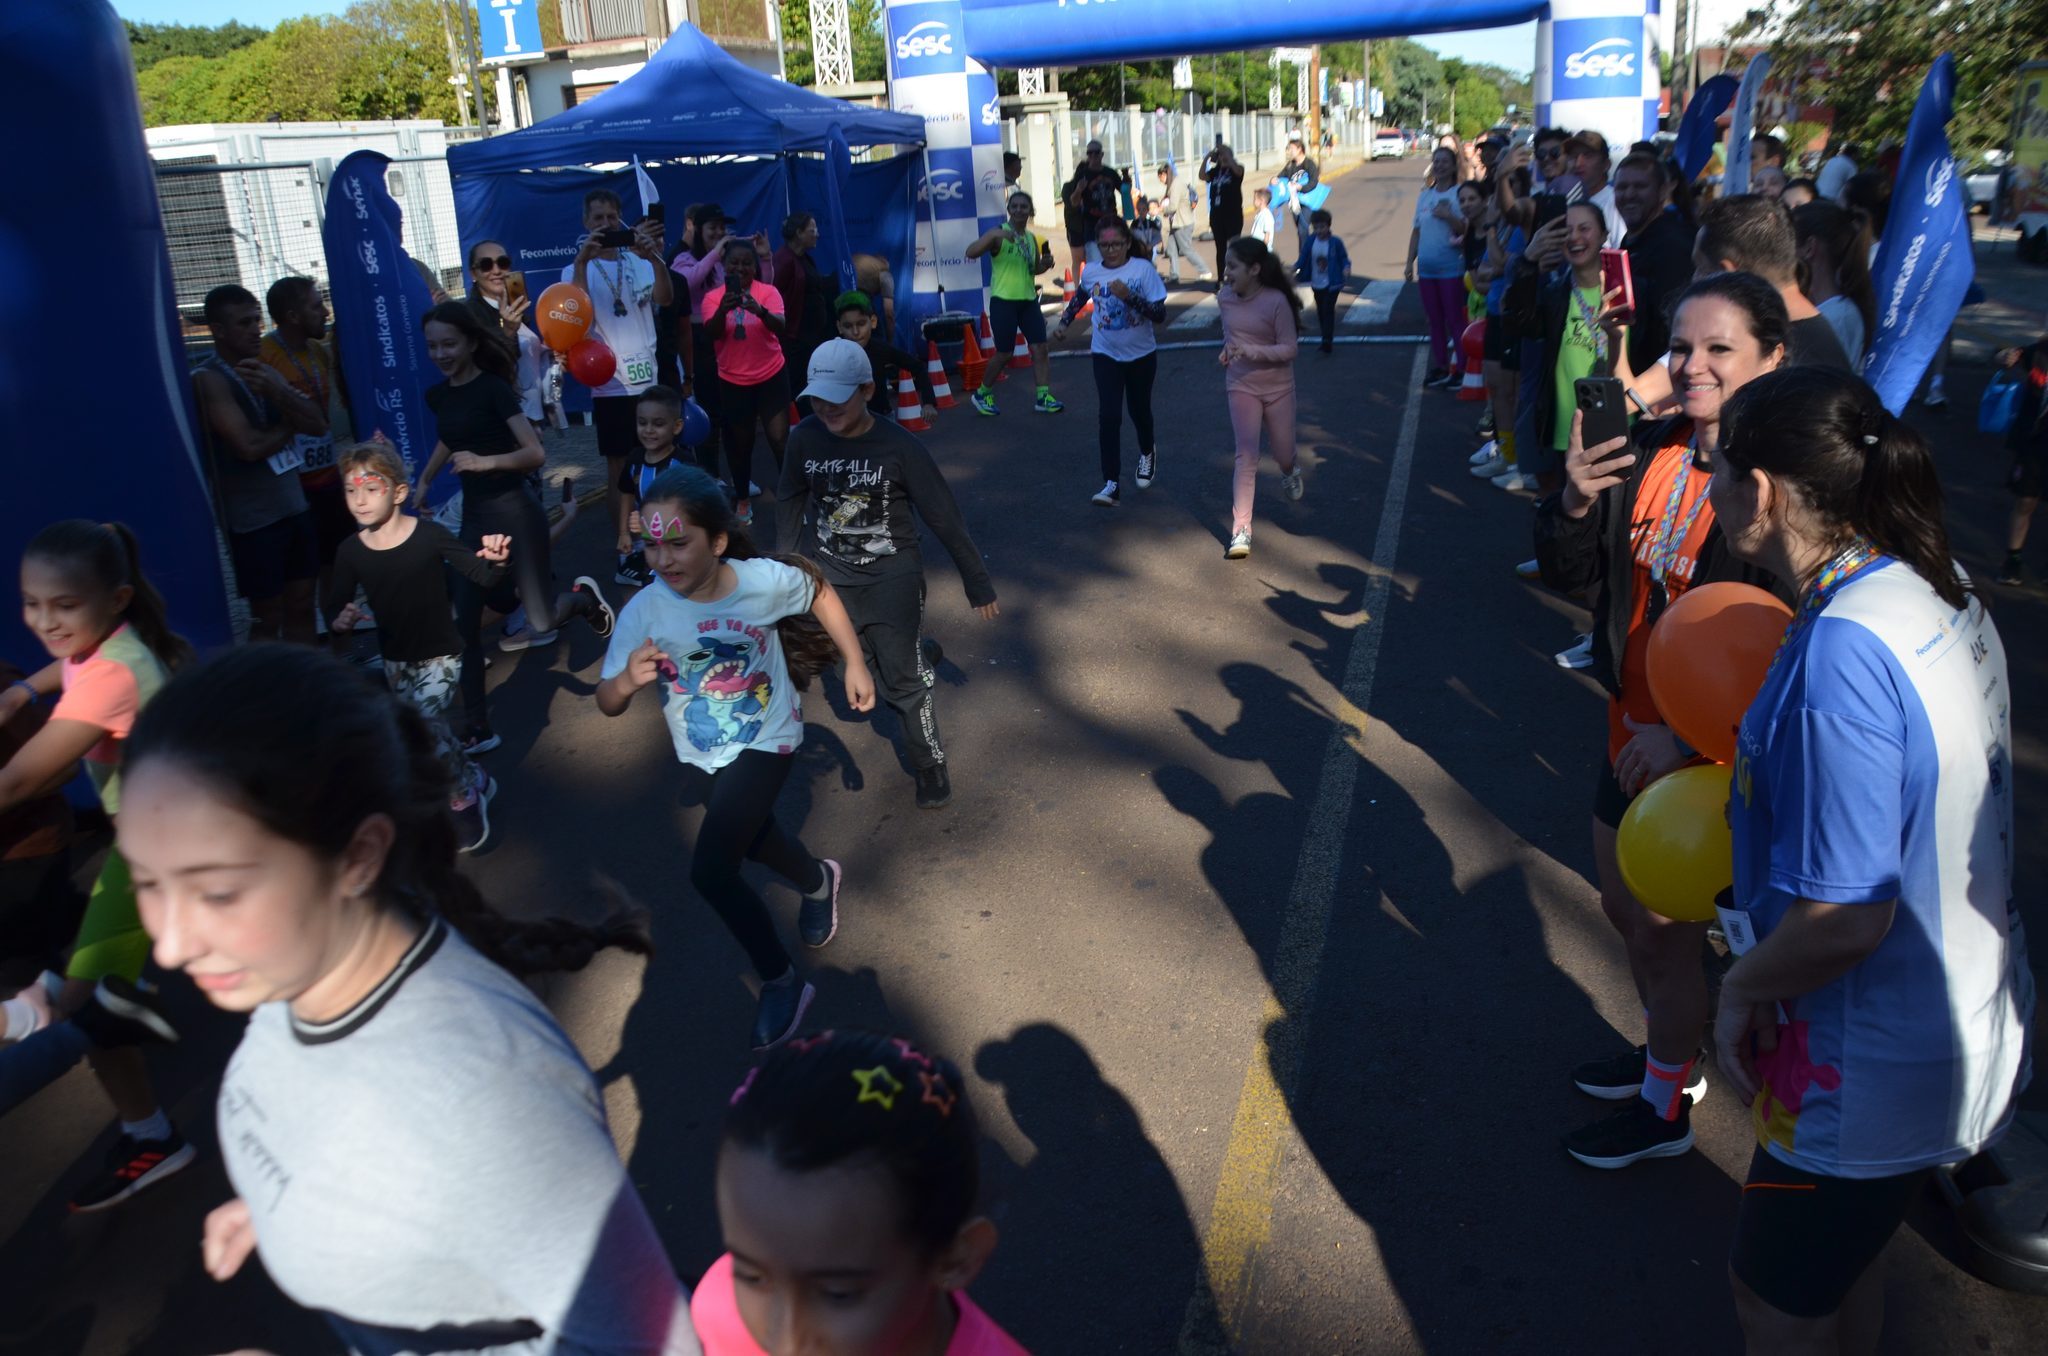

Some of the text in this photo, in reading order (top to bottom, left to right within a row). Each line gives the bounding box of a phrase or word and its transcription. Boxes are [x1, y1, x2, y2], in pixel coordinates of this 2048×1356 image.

[520, 246, 577, 260] Fecomércio
[549, 310, 584, 326] CRESOL
[374, 295, 396, 367] Sindicatos
[626, 360, 653, 383] 566
[388, 387, 403, 409] RS
[804, 459, 873, 474] SKATE ALL
[848, 465, 883, 488] DAY!
[697, 619, 718, 633] SEE
[726, 619, 743, 632] YA
